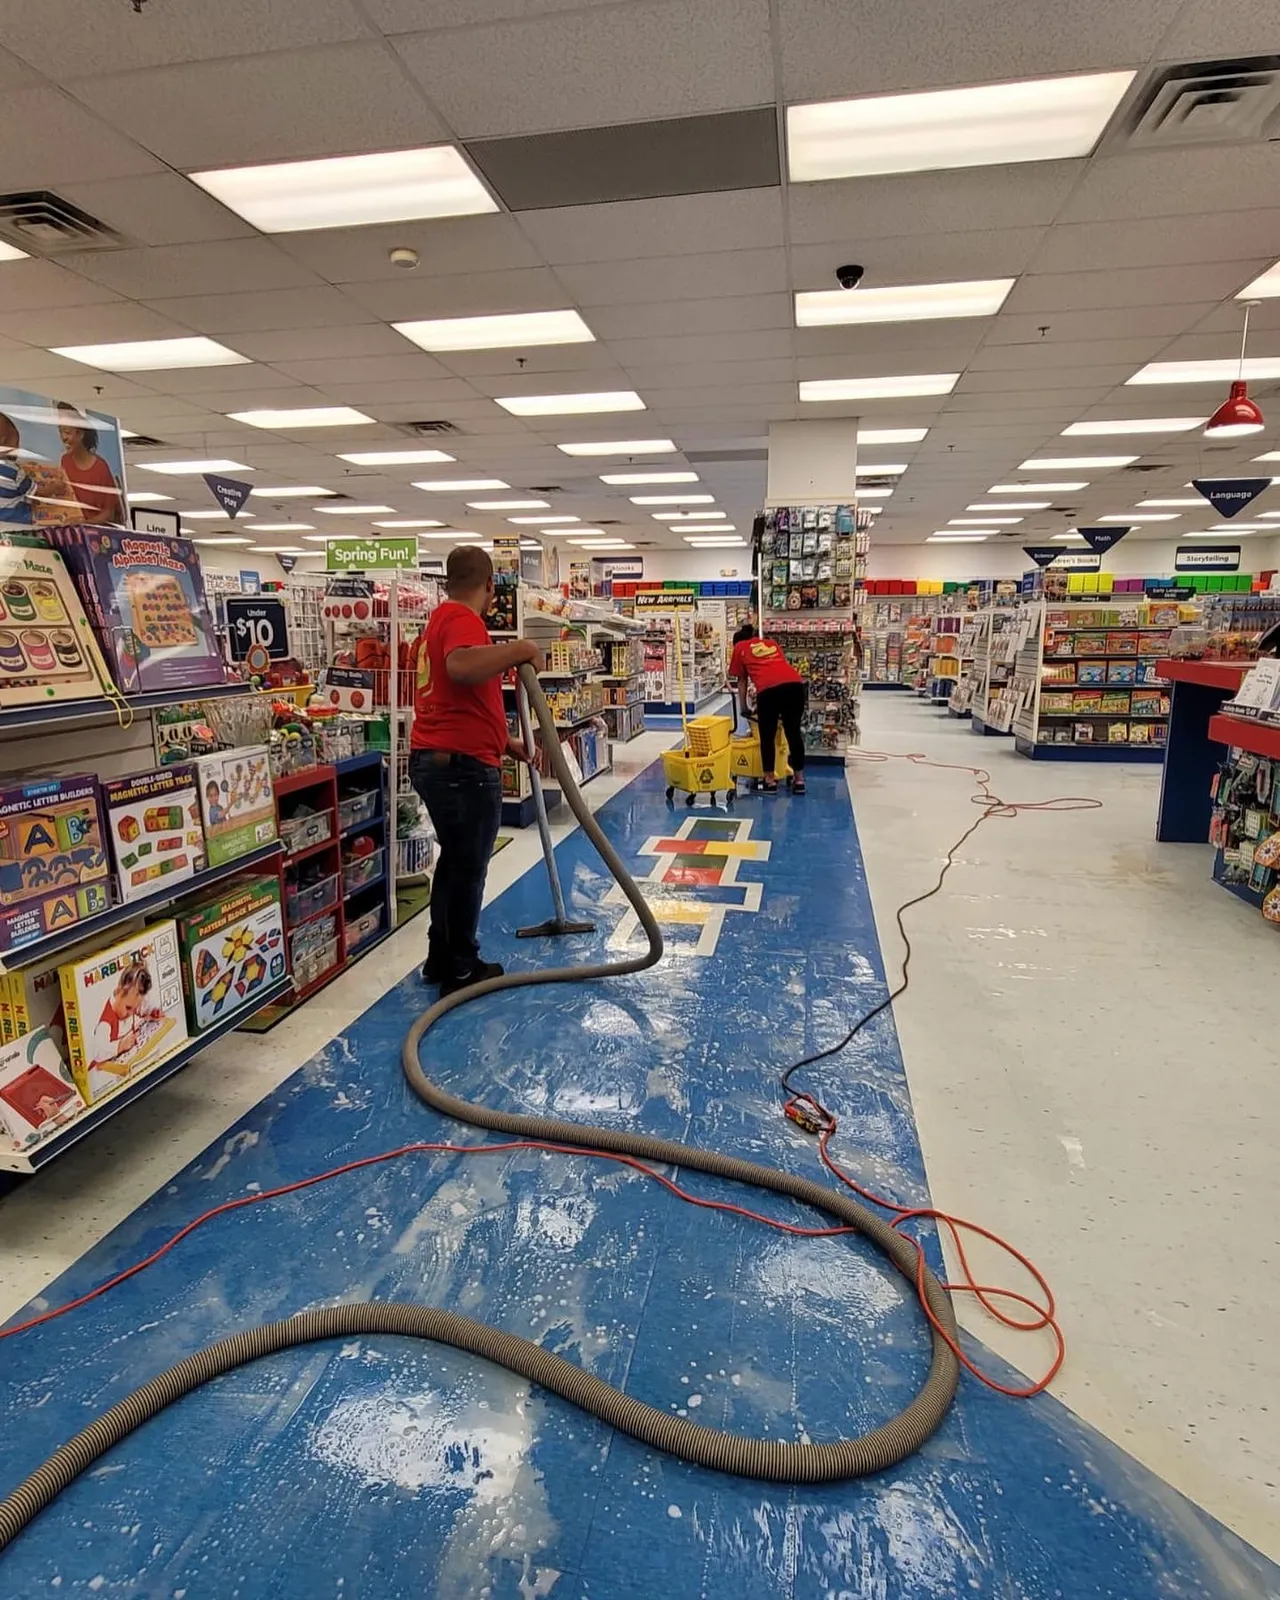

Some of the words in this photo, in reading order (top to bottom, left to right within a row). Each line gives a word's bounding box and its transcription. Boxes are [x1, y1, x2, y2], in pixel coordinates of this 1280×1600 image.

[217, 485, 242, 498] Creative
[1210, 490, 1252, 500] Language
[224, 497, 237, 508] Play
[146, 524, 166, 534] Line
[122, 538, 171, 557] Magnetic
[335, 546, 377, 563] Spring
[380, 547, 409, 560] Fun!
[113, 553, 157, 568] Alphabet
[158, 557, 187, 572] Maze
[1186, 554, 1229, 564] Storytelling
[637, 596, 655, 604] NEW
[247, 609, 267, 617] Under
[237, 617, 274, 647] $10
[110, 784, 149, 802] MAGNETIC
[150, 778, 175, 792] LETTER
[0, 801, 32, 816] AGNETIC
[33, 794, 59, 808] LETTER
[60, 786, 94, 801] BUILDERS
[6, 908, 41, 926] MAGNETIC
[14, 917, 36, 930] LETTER
[10, 922, 41, 938] BUILDERS
